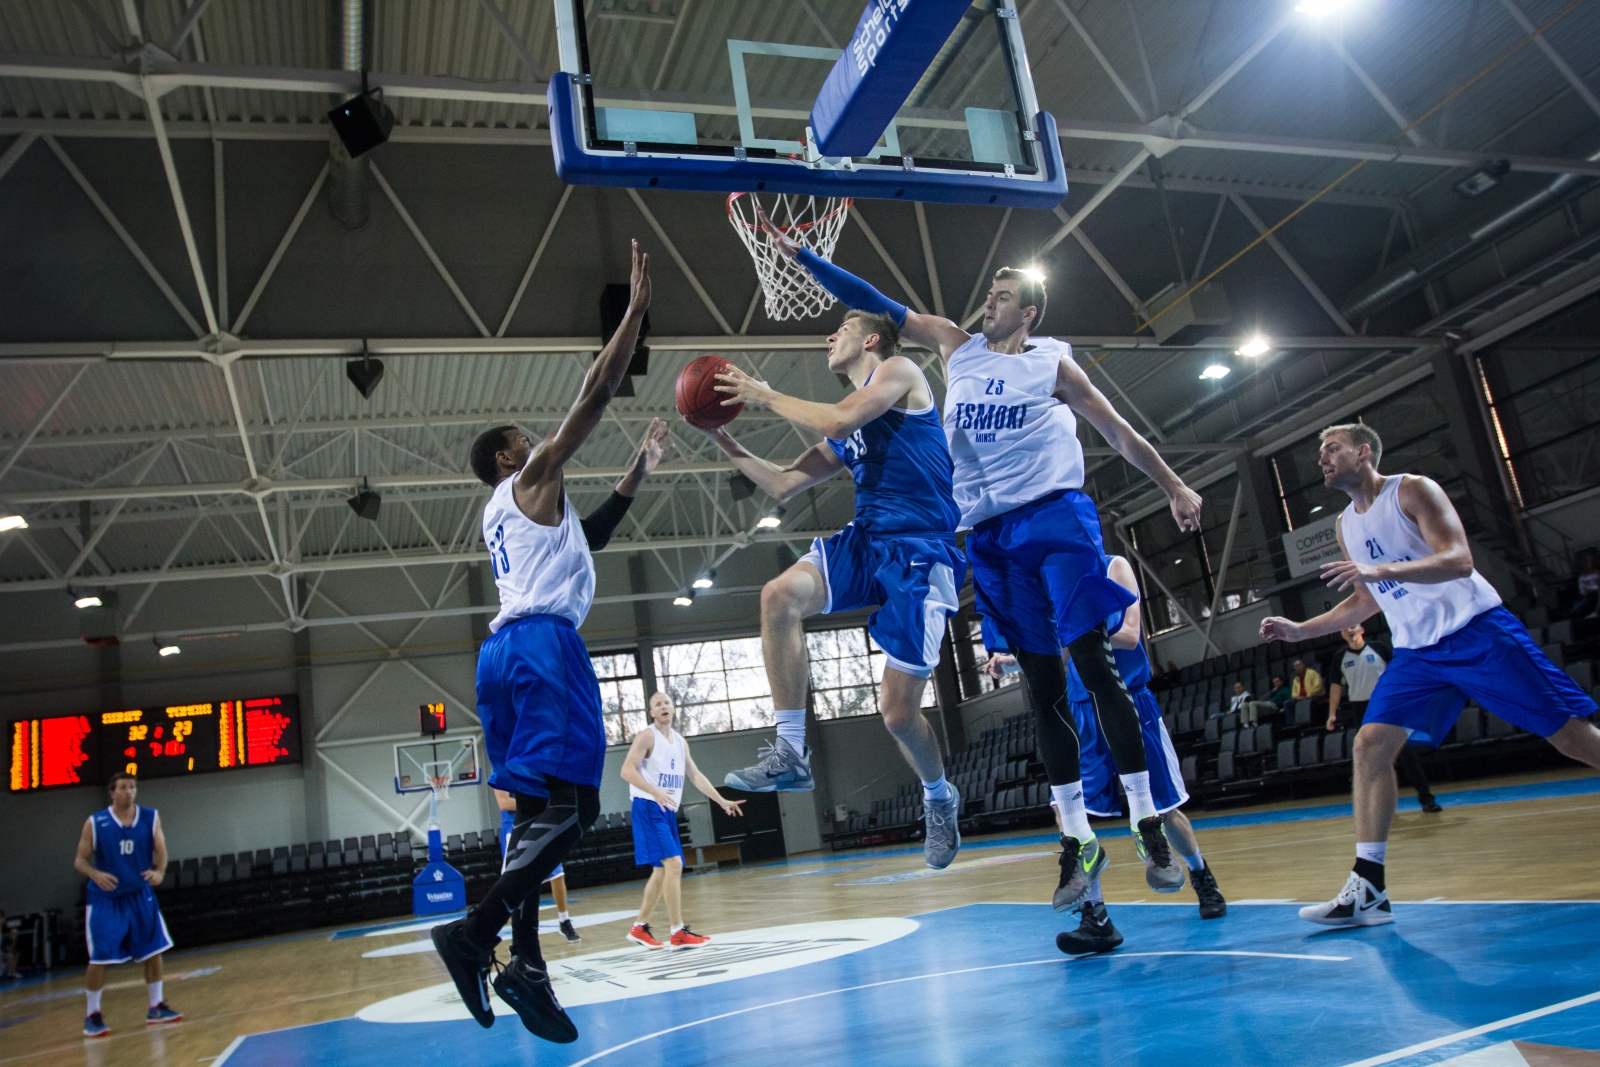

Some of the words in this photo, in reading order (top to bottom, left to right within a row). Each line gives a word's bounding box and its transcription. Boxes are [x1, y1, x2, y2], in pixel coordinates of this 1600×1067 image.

[985, 377, 1005, 395] 23
[975, 433, 997, 443] MINSK
[1365, 537, 1384, 560] 21
[670, 758, 675, 770] 6
[119, 839, 135, 855] 10
